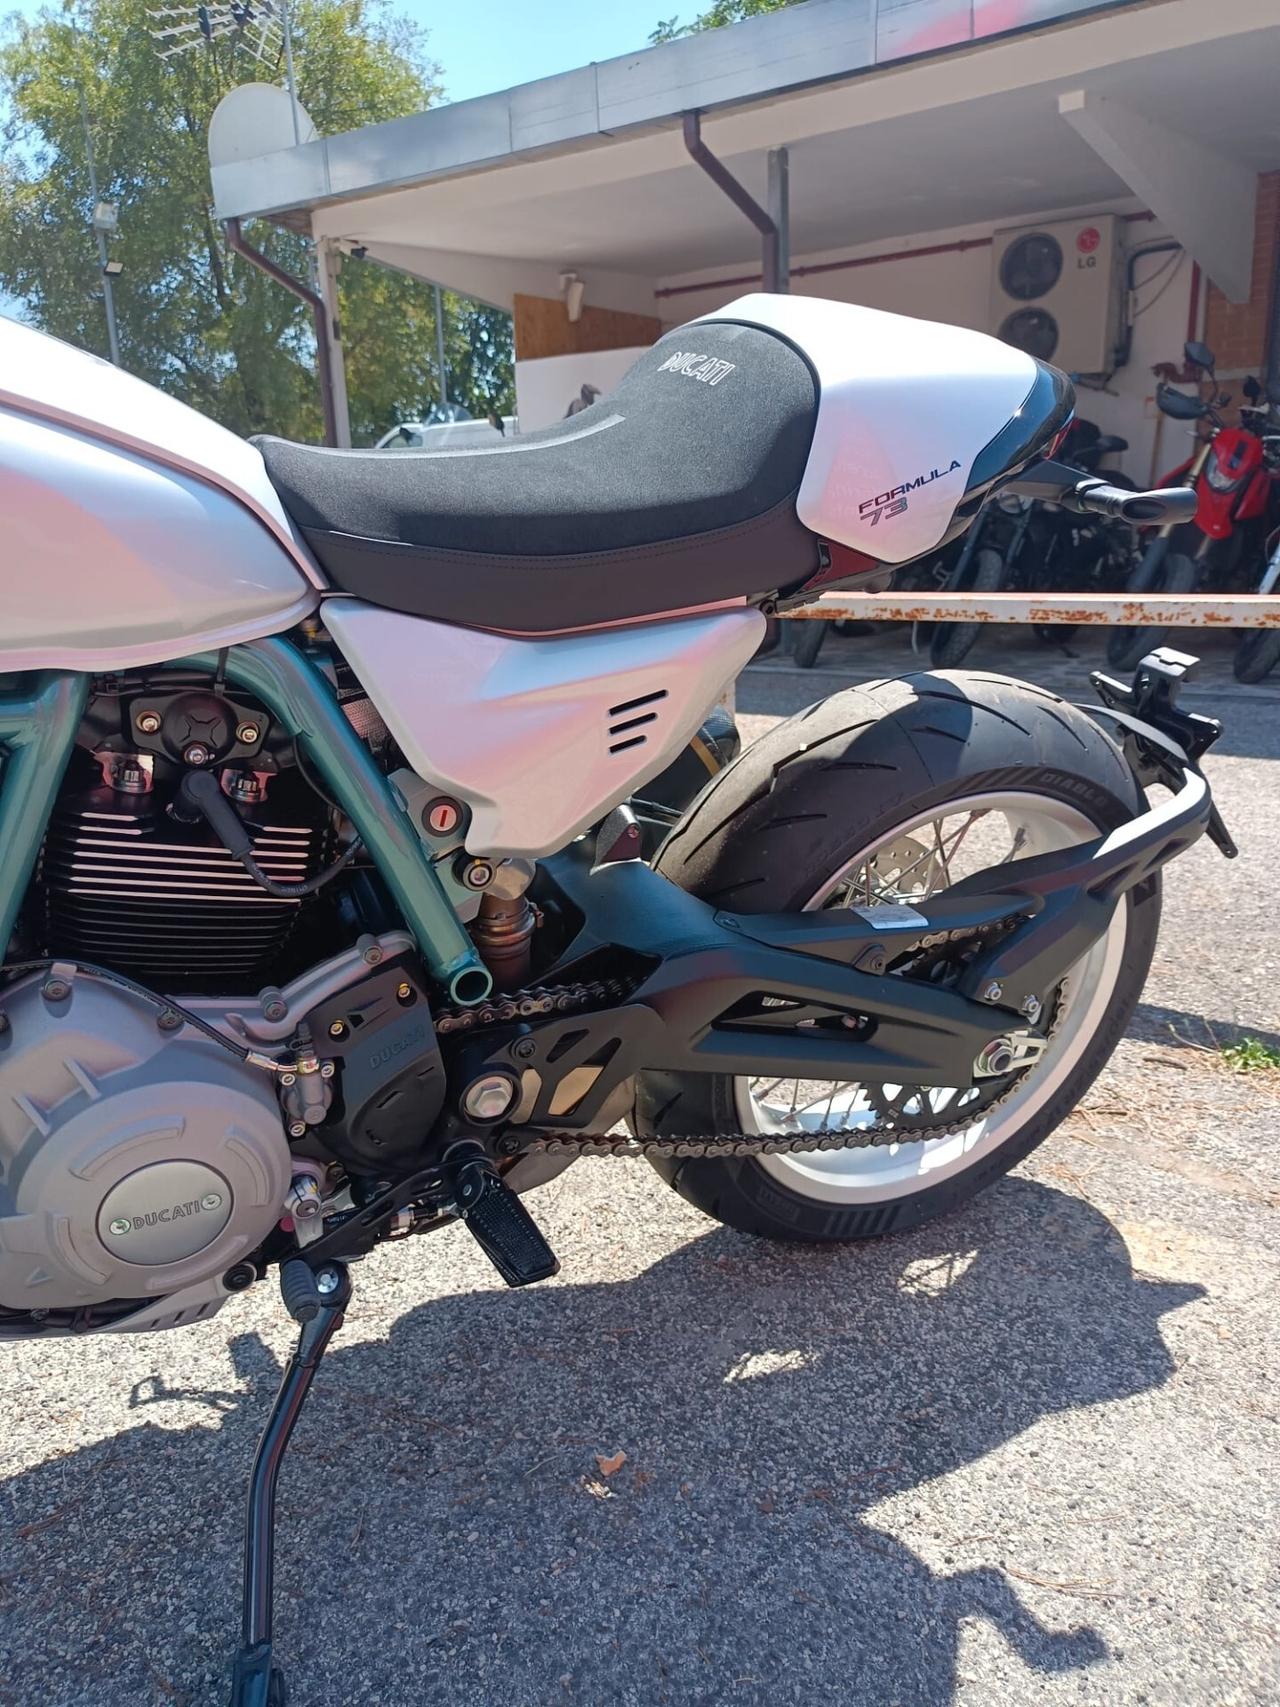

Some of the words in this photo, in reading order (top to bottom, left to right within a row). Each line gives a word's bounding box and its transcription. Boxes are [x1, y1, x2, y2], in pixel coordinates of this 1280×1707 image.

[1077, 256, 1097, 269] LG
[656, 351, 737, 386] DUCATI
[858, 459, 962, 514] FORMULA
[859, 496, 909, 527] 73
[1039, 773, 1109, 807] DIABLO
[132, 1199, 201, 1230] DUCATI
